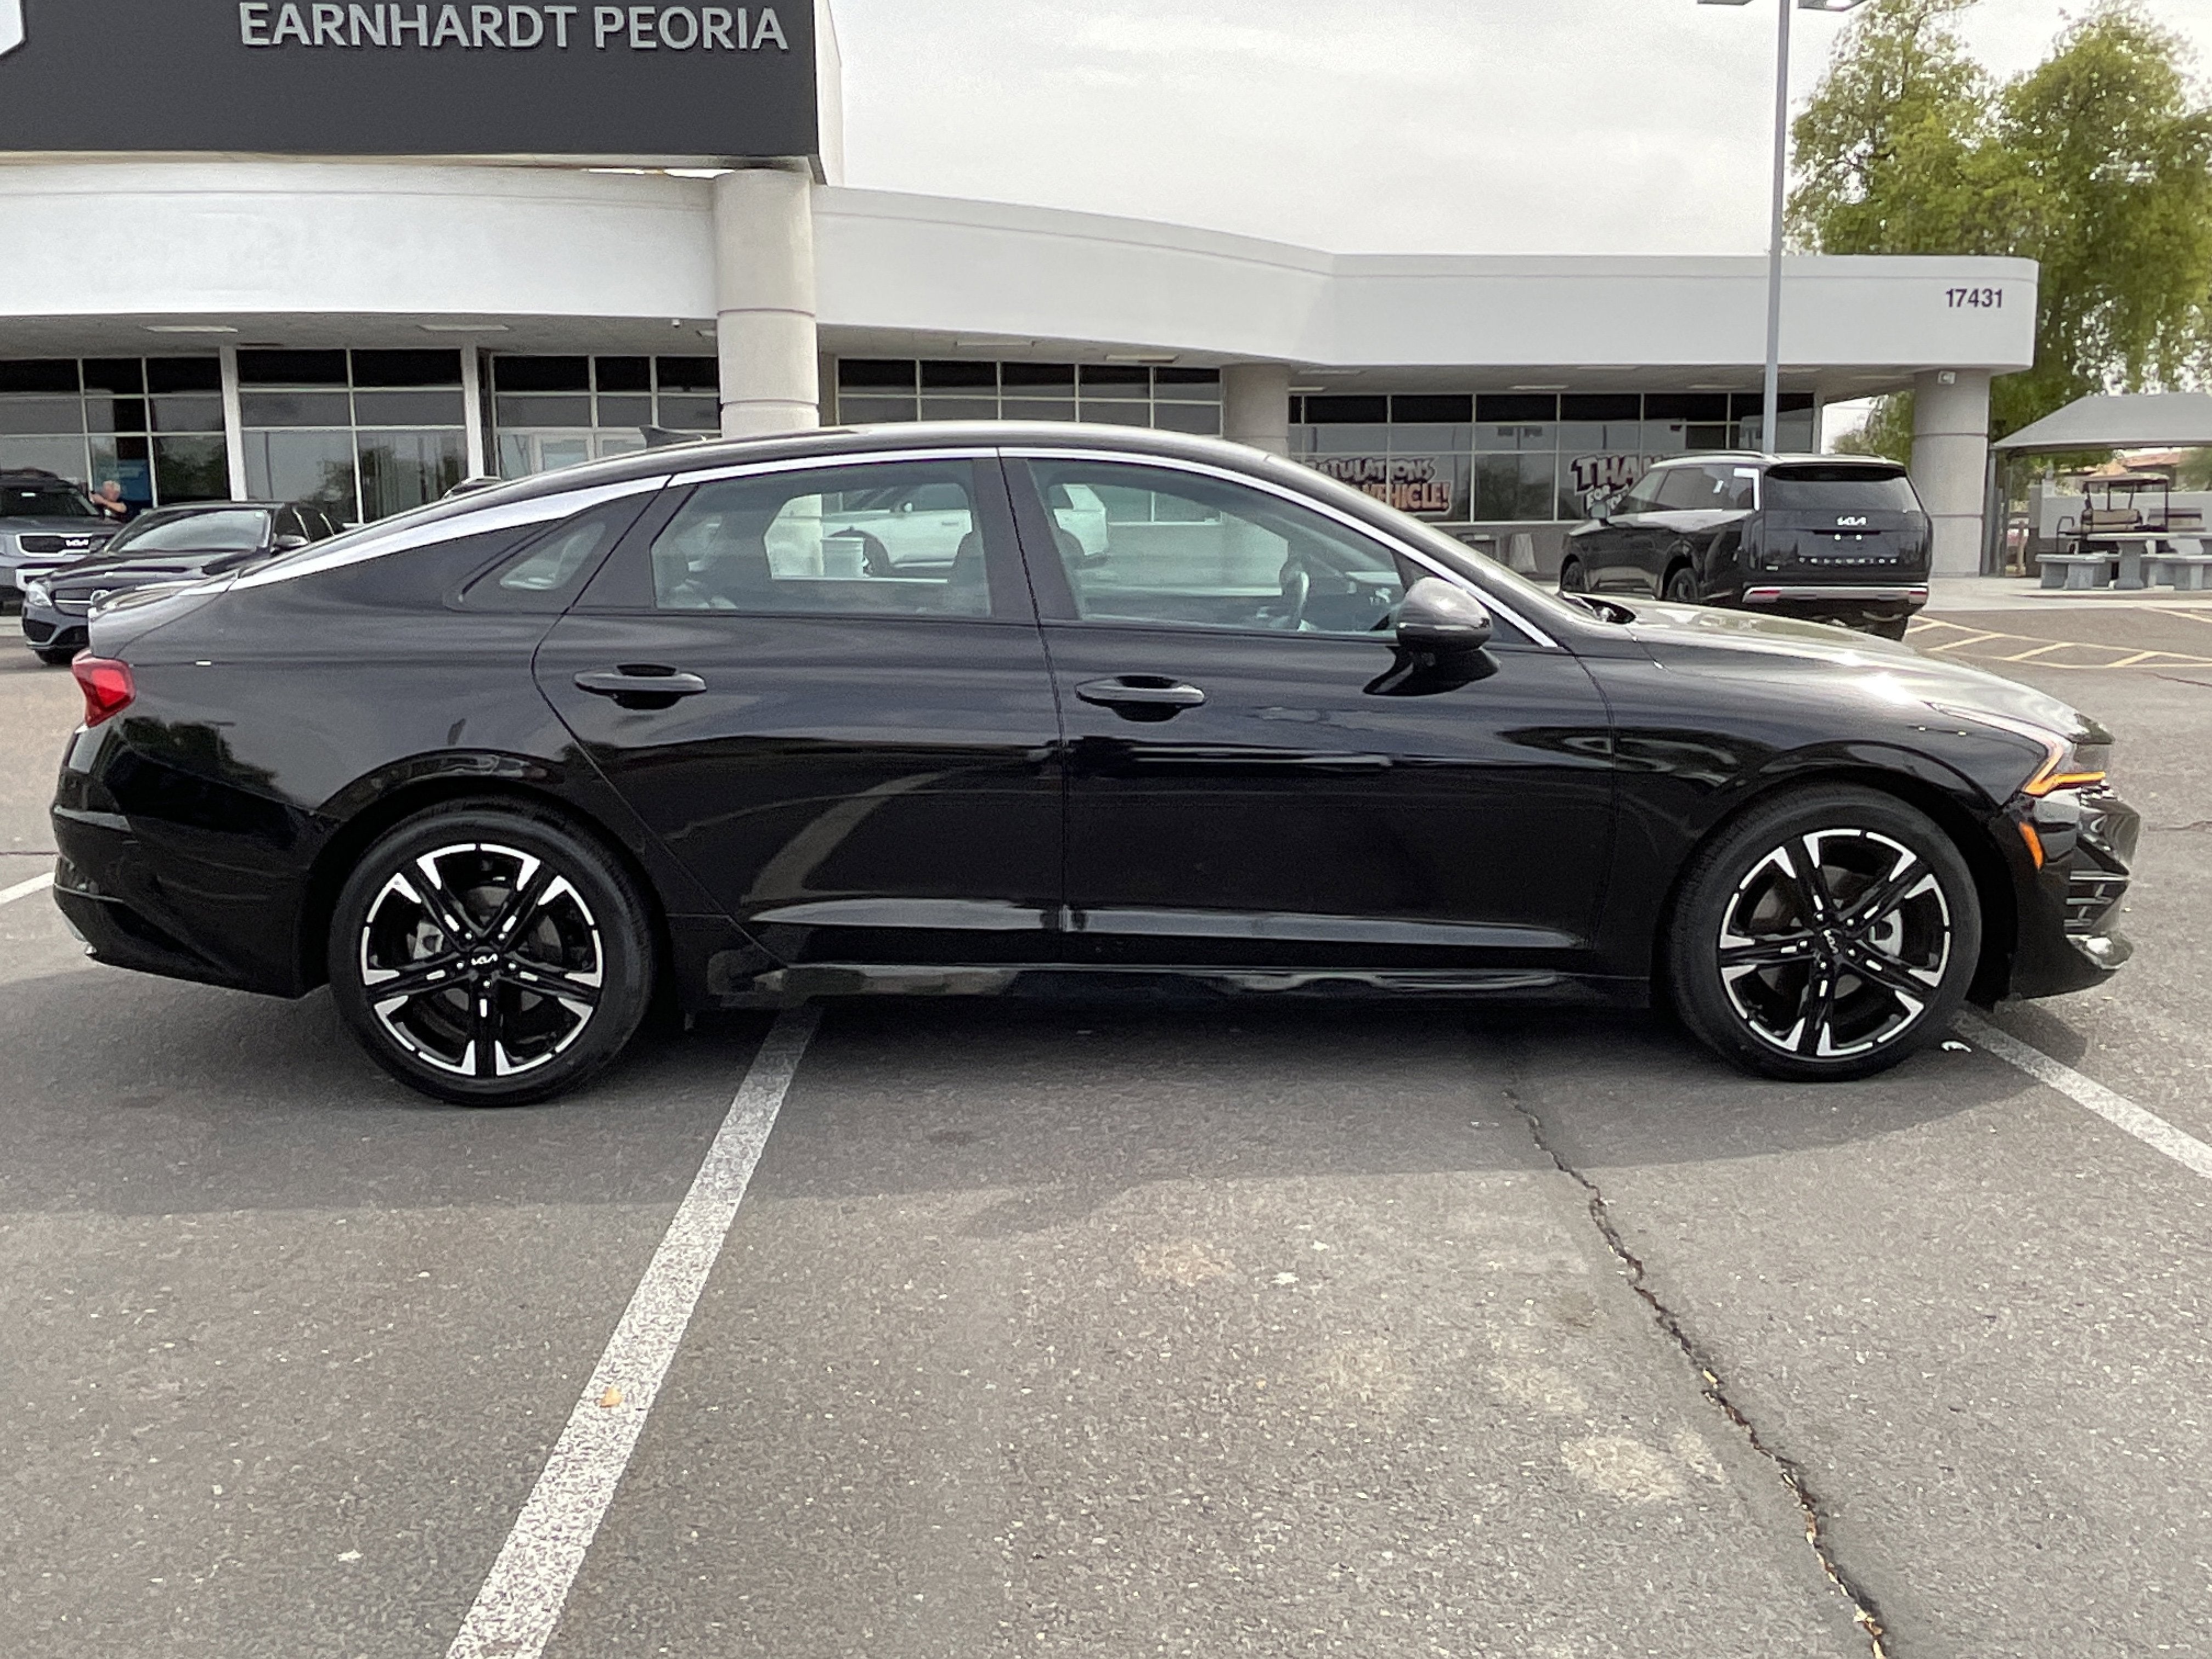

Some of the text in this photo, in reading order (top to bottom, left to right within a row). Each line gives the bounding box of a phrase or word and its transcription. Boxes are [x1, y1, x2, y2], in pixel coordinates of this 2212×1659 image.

[240, 3, 789, 50] EARNHARDT PEORIA
[1946, 288, 2002, 308] 17431
